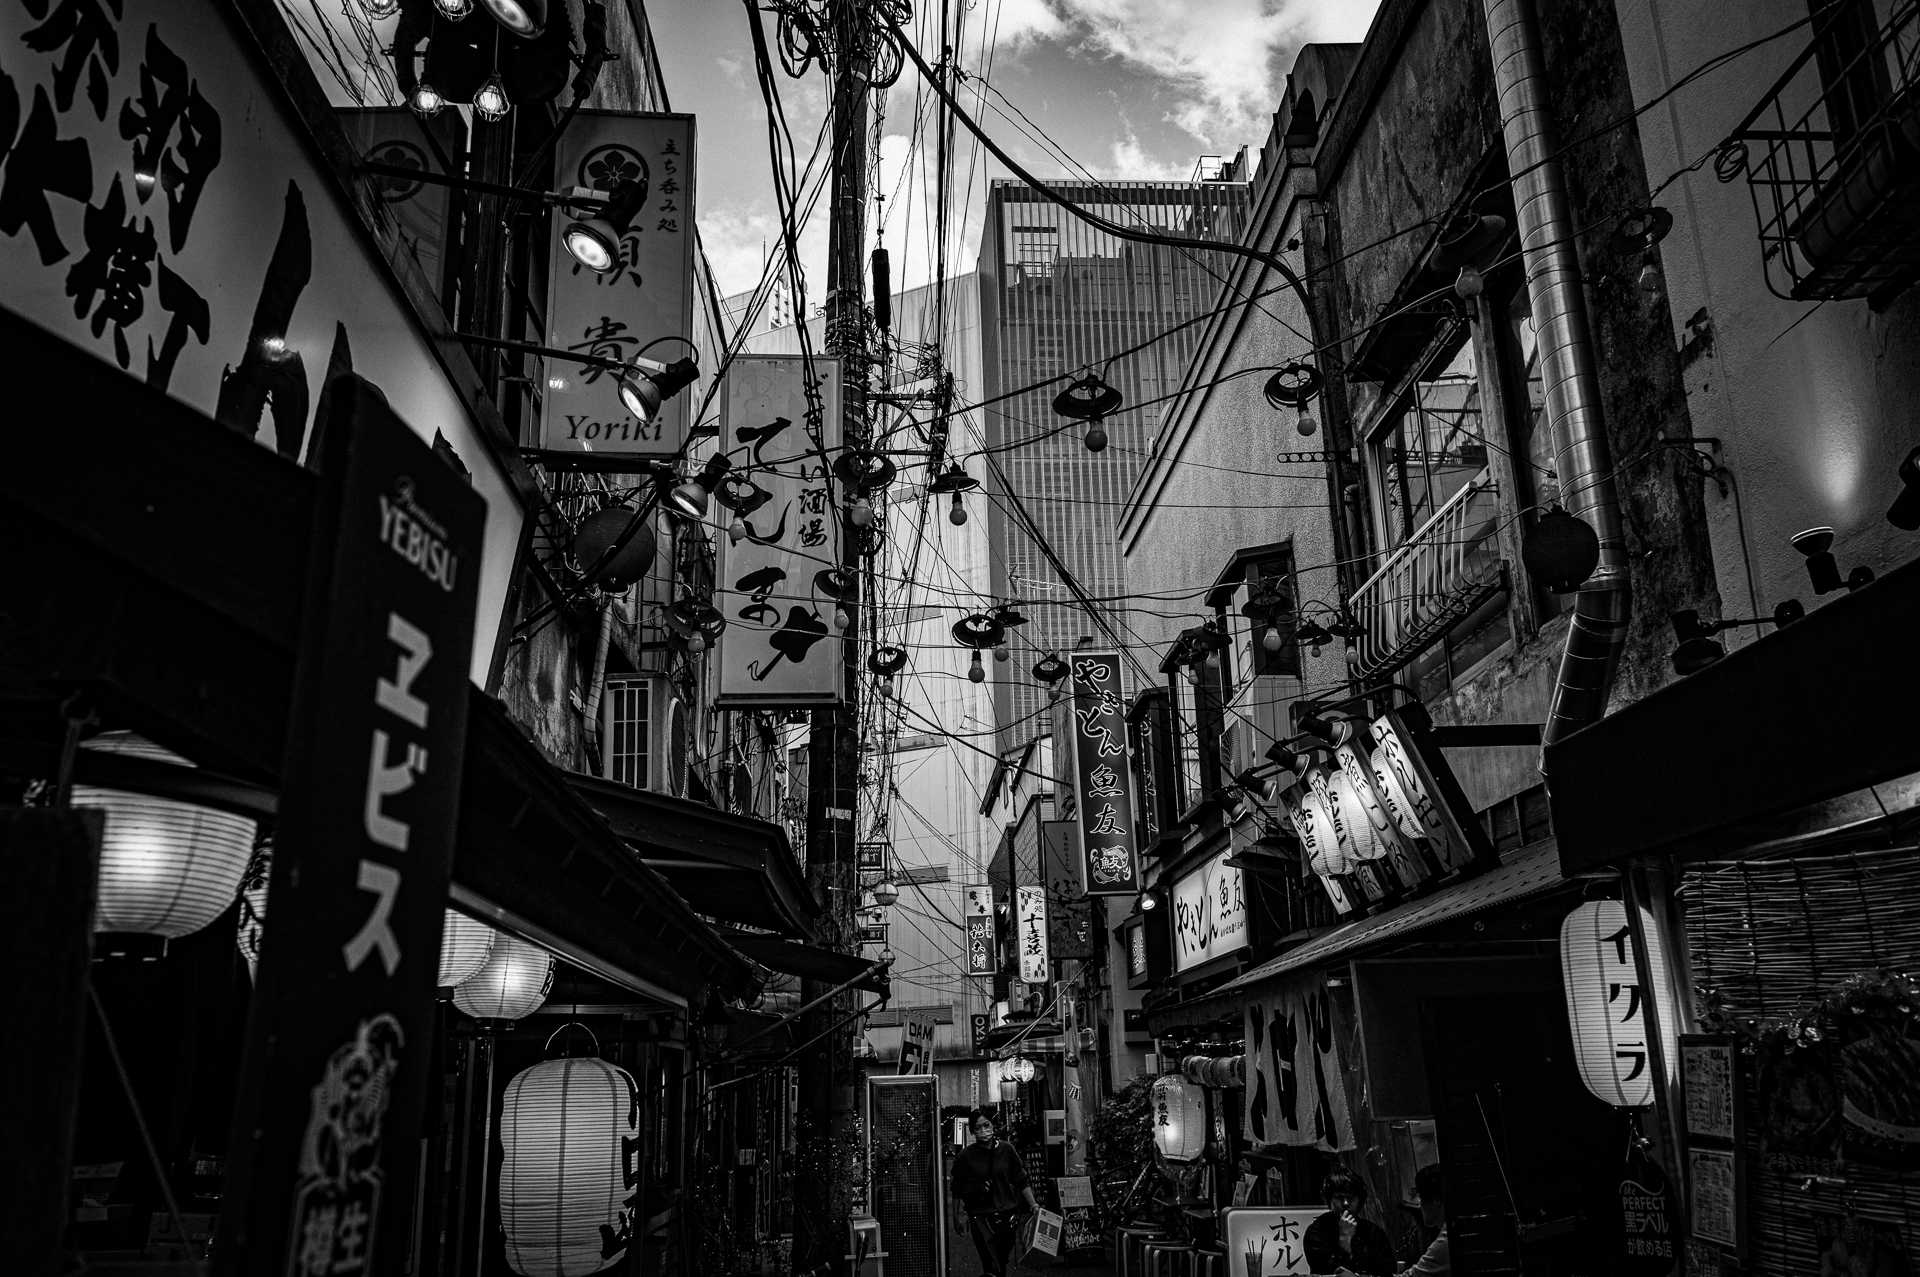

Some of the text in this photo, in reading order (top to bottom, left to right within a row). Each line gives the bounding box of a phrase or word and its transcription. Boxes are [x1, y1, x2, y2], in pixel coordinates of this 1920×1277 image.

[565, 415, 663, 441] Yoriki
[379, 493, 458, 592] YEBISU
[1075, 658, 1125, 757] やきとん
[1088, 763, 1127, 835] 魚友
[1375, 725, 1450, 868] ホルモン
[1599, 924, 1646, 1082] イクラ
[1624, 1211, 1670, 1234] 黒ラベル
[1625, 1239, 1673, 1259] が飲める店
